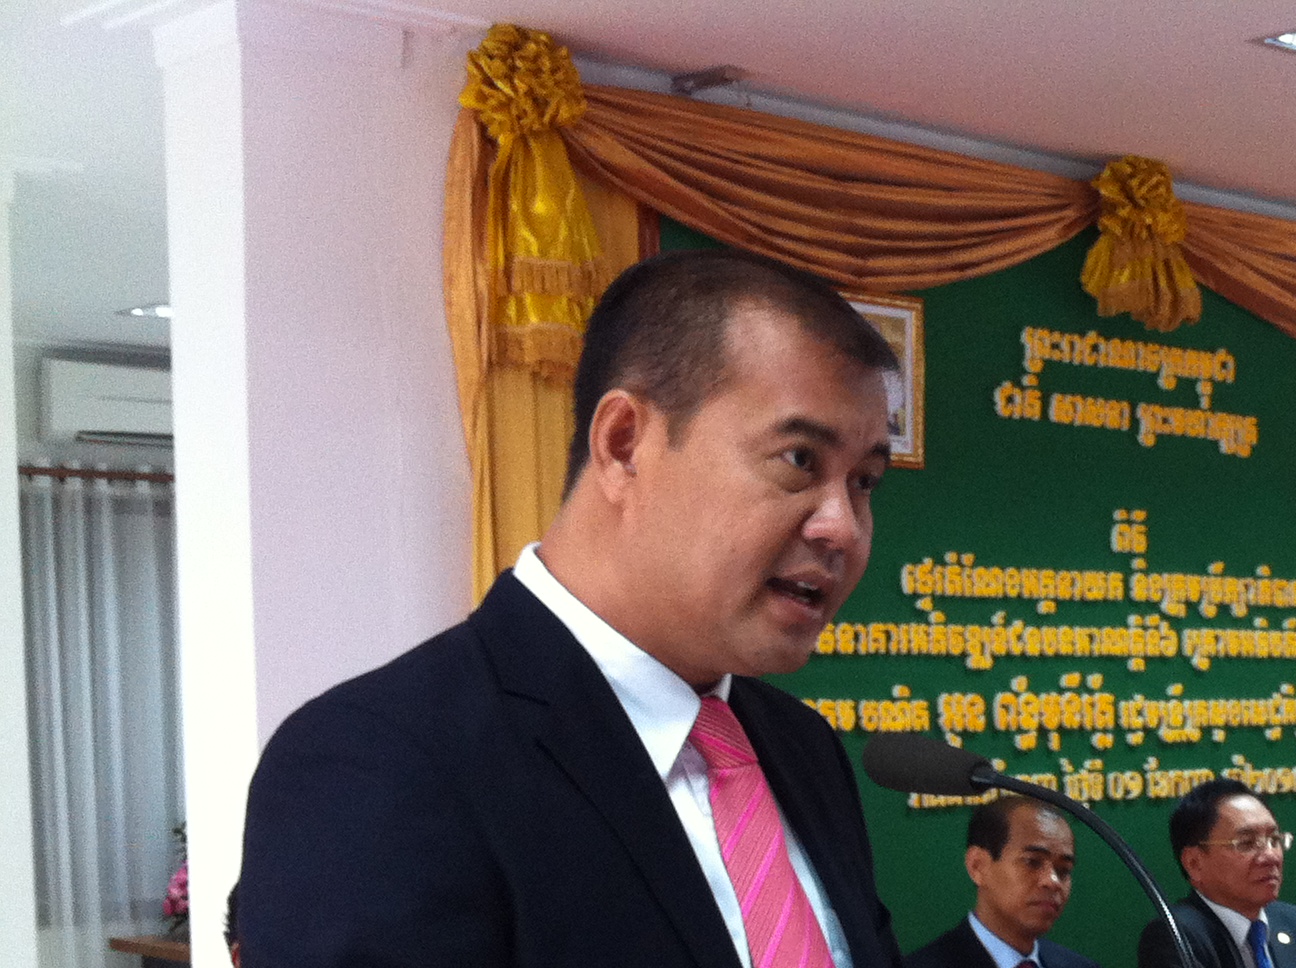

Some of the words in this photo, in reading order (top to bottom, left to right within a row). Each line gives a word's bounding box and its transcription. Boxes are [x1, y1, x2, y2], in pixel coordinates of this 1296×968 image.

[1020, 326, 1236, 410] ព្រះរាជាណាចក្រកម្ពុជា
[993, 372, 1043, 421] ជាតិ
[1048, 392, 1131, 432] សាសនា
[1136, 402, 1259, 459] ព្រះមហាក្សត្រ
[1110, 509, 1149, 554] ពិធី
[857, 683, 931, 734] បណ្ិត
[1059, 757, 1105, 808] ថ្ៃទី
[1143, 756, 1216, 800] ខែកញ្ា
